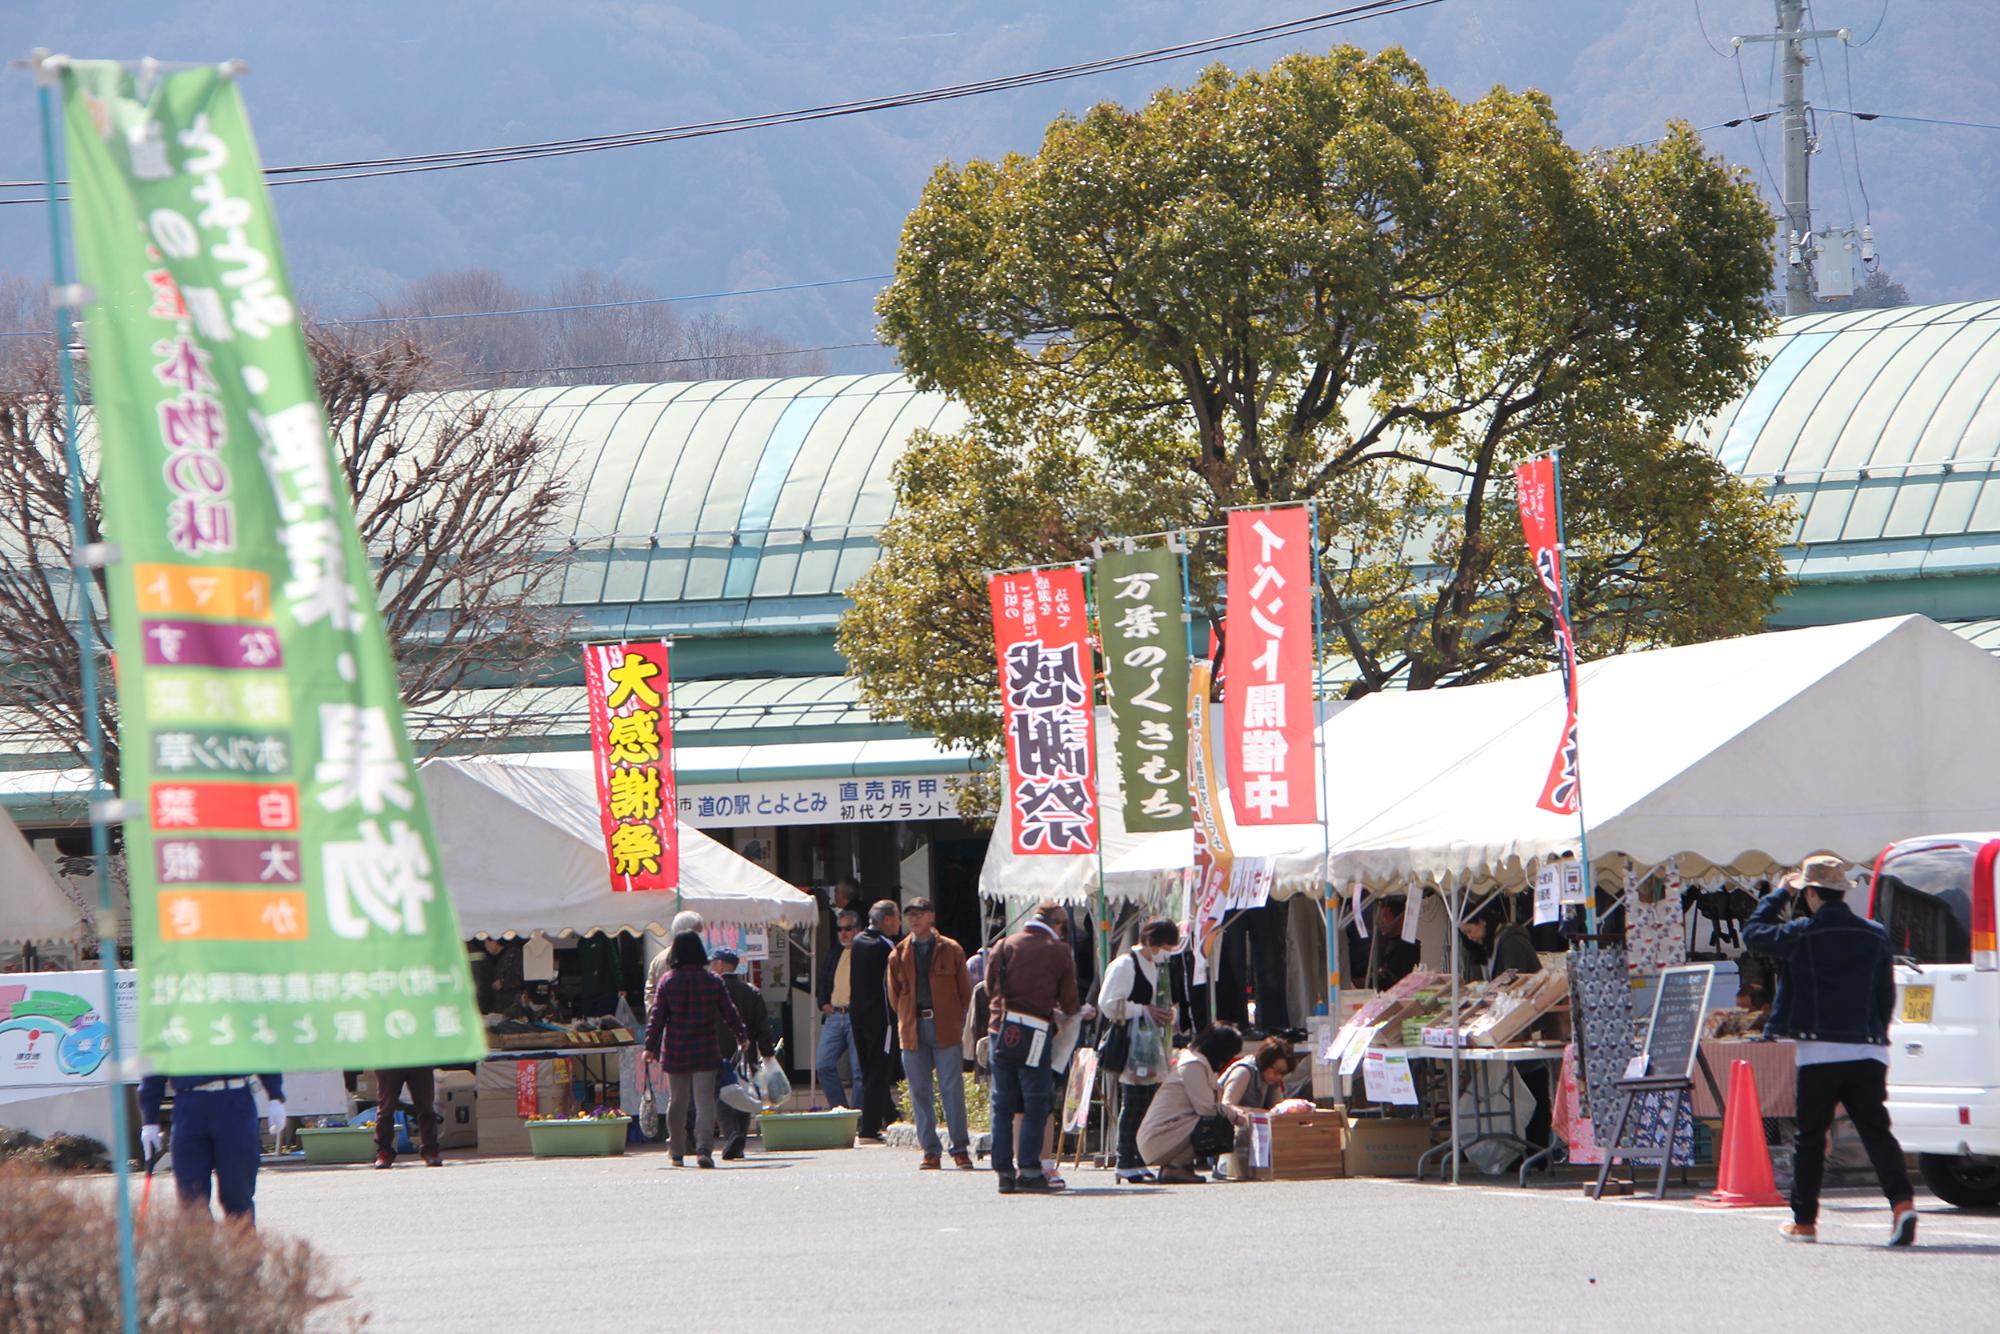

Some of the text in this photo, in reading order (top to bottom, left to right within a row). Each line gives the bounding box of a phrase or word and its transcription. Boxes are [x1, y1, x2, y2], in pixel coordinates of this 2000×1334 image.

[606, 651, 664, 877] 大感謝祭
[698, 794, 750, 817] 道の駅
[757, 792, 828, 814] とよとみ
[1111, 571, 1184, 818] 万葉のくさもち
